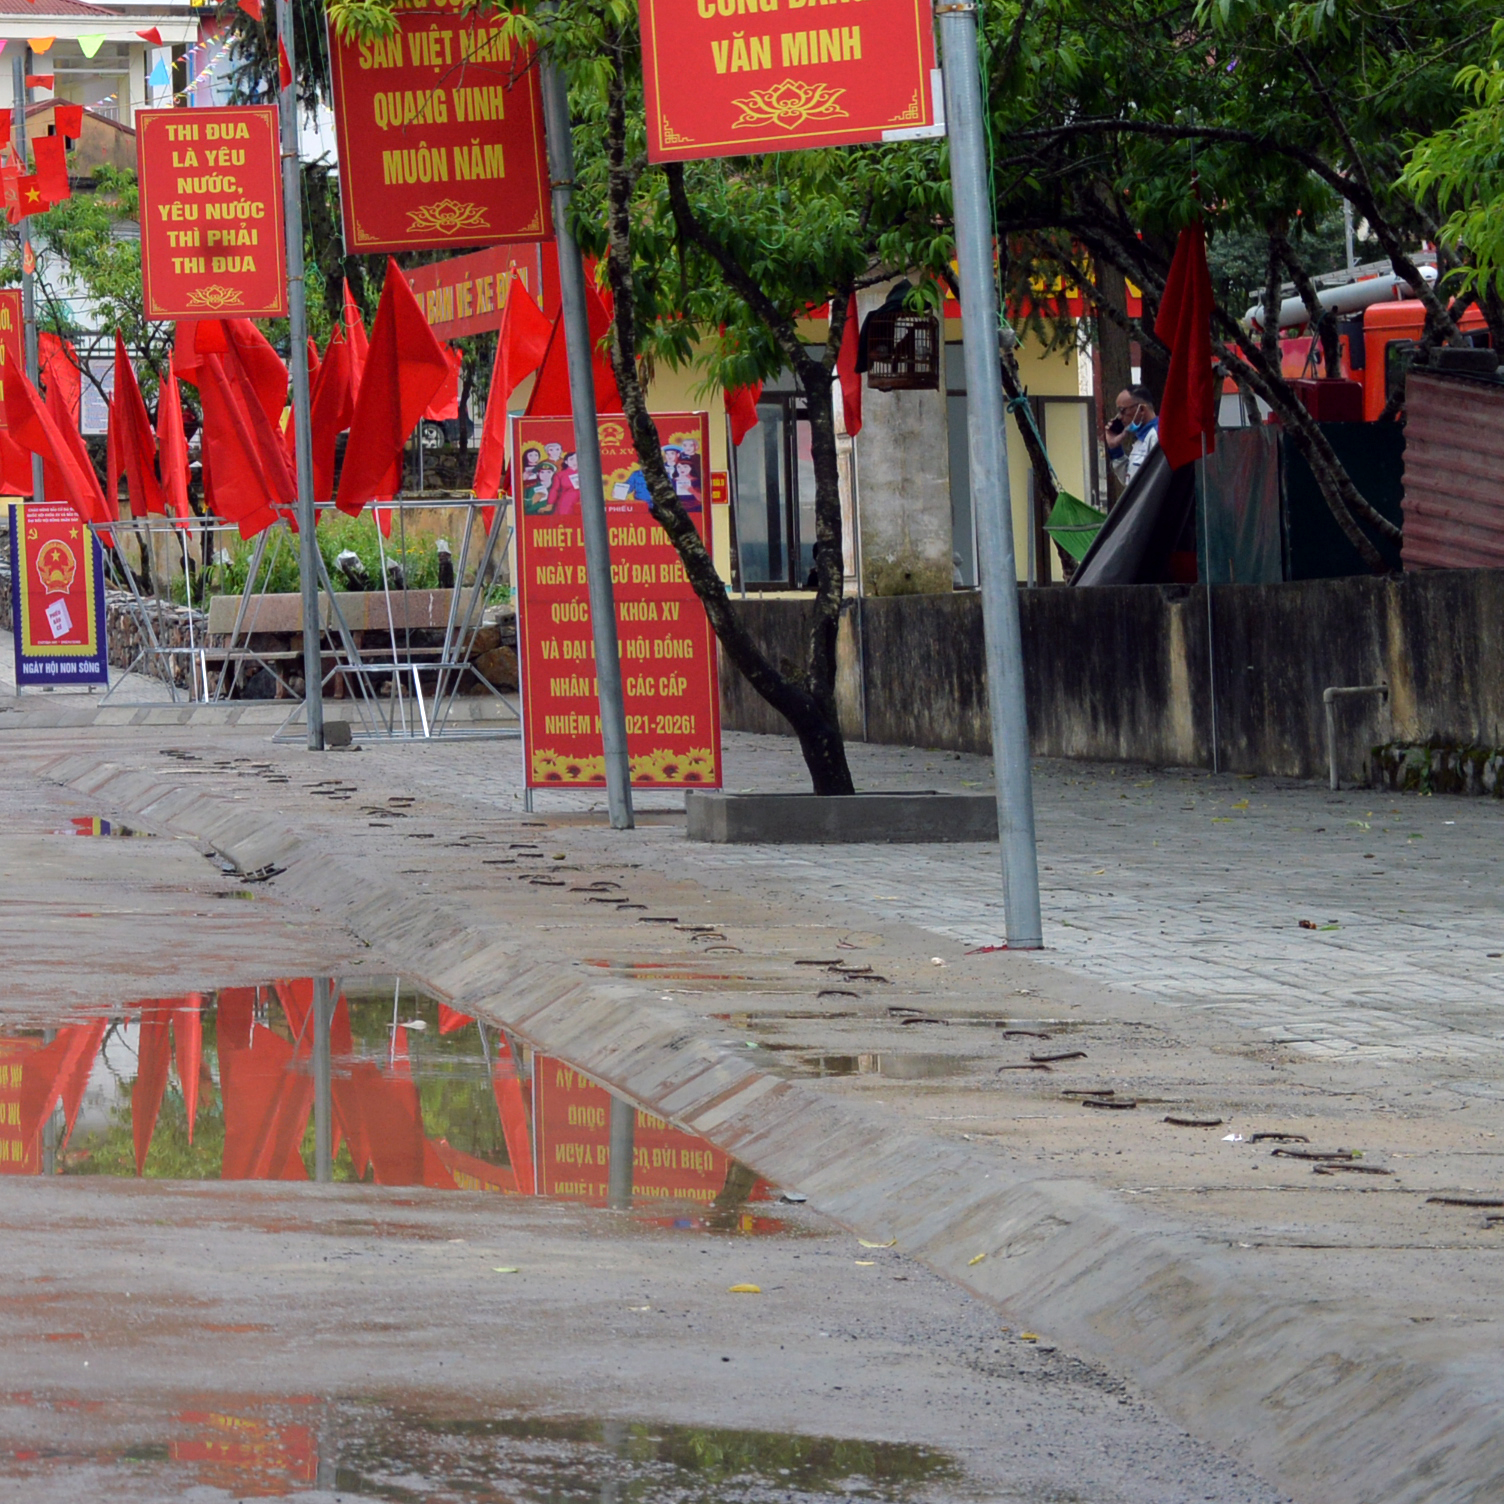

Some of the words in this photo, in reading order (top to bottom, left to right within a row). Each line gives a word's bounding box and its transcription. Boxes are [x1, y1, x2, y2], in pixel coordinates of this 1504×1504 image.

[408, 23, 453, 74] VIỆT
[459, 27, 511, 63] NAM
[711, 29, 772, 75] VĂN
[780, 25, 862, 69] MINH
[373, 89, 448, 131] QUANG
[453, 85, 505, 122] VINH
[165, 124, 199, 141] THI
[205, 122, 250, 141] ĐUA
[172, 147, 198, 167] LÀ
[205, 146, 246, 166] YÊU
[382, 140, 448, 186] MUÔN
[454, 137, 505, 181] NĂM
[177, 171, 244, 195] NƯỚC,
[158, 201, 199, 221] YÊU
[205, 198, 265, 220] NƯỚC
[167, 227, 200, 247] THÌ
[207, 222, 258, 246] PHẢI
[172, 257, 205, 274] THI
[212, 256, 256, 273] ĐUA
[427, 279, 454, 326] BÁN
[456, 272, 473, 319] VÉ
[476, 275, 494, 315] XE
[533, 524, 572, 552] NHIỆT
[609, 523, 647, 546] CHÀO
[536, 562, 573, 585] NGÀY
[610, 558, 630, 584] CỬ
[632, 564, 656, 587] ĐẠI
[551, 596, 589, 624] QUỐC
[620, 598, 658, 621] KHÓA
[661, 602, 680, 621] XV
[541, 636, 560, 660] VÀ
[563, 640, 587, 663] ĐẠI
[627, 636, 650, 663] HỘI
[654, 633, 693, 659] ĐỒNG
[22, 661, 44, 674] NGÀY
[45, 661, 59, 676] HỘI
[60, 662, 77, 674] NON
[550, 674, 590, 697] NHÂN
[627, 673, 655, 696] CÁC
[659, 670, 688, 696] CẤP
[545, 711, 591, 738] NHIỆM
[625, 715, 696, 734] 021-2026!
